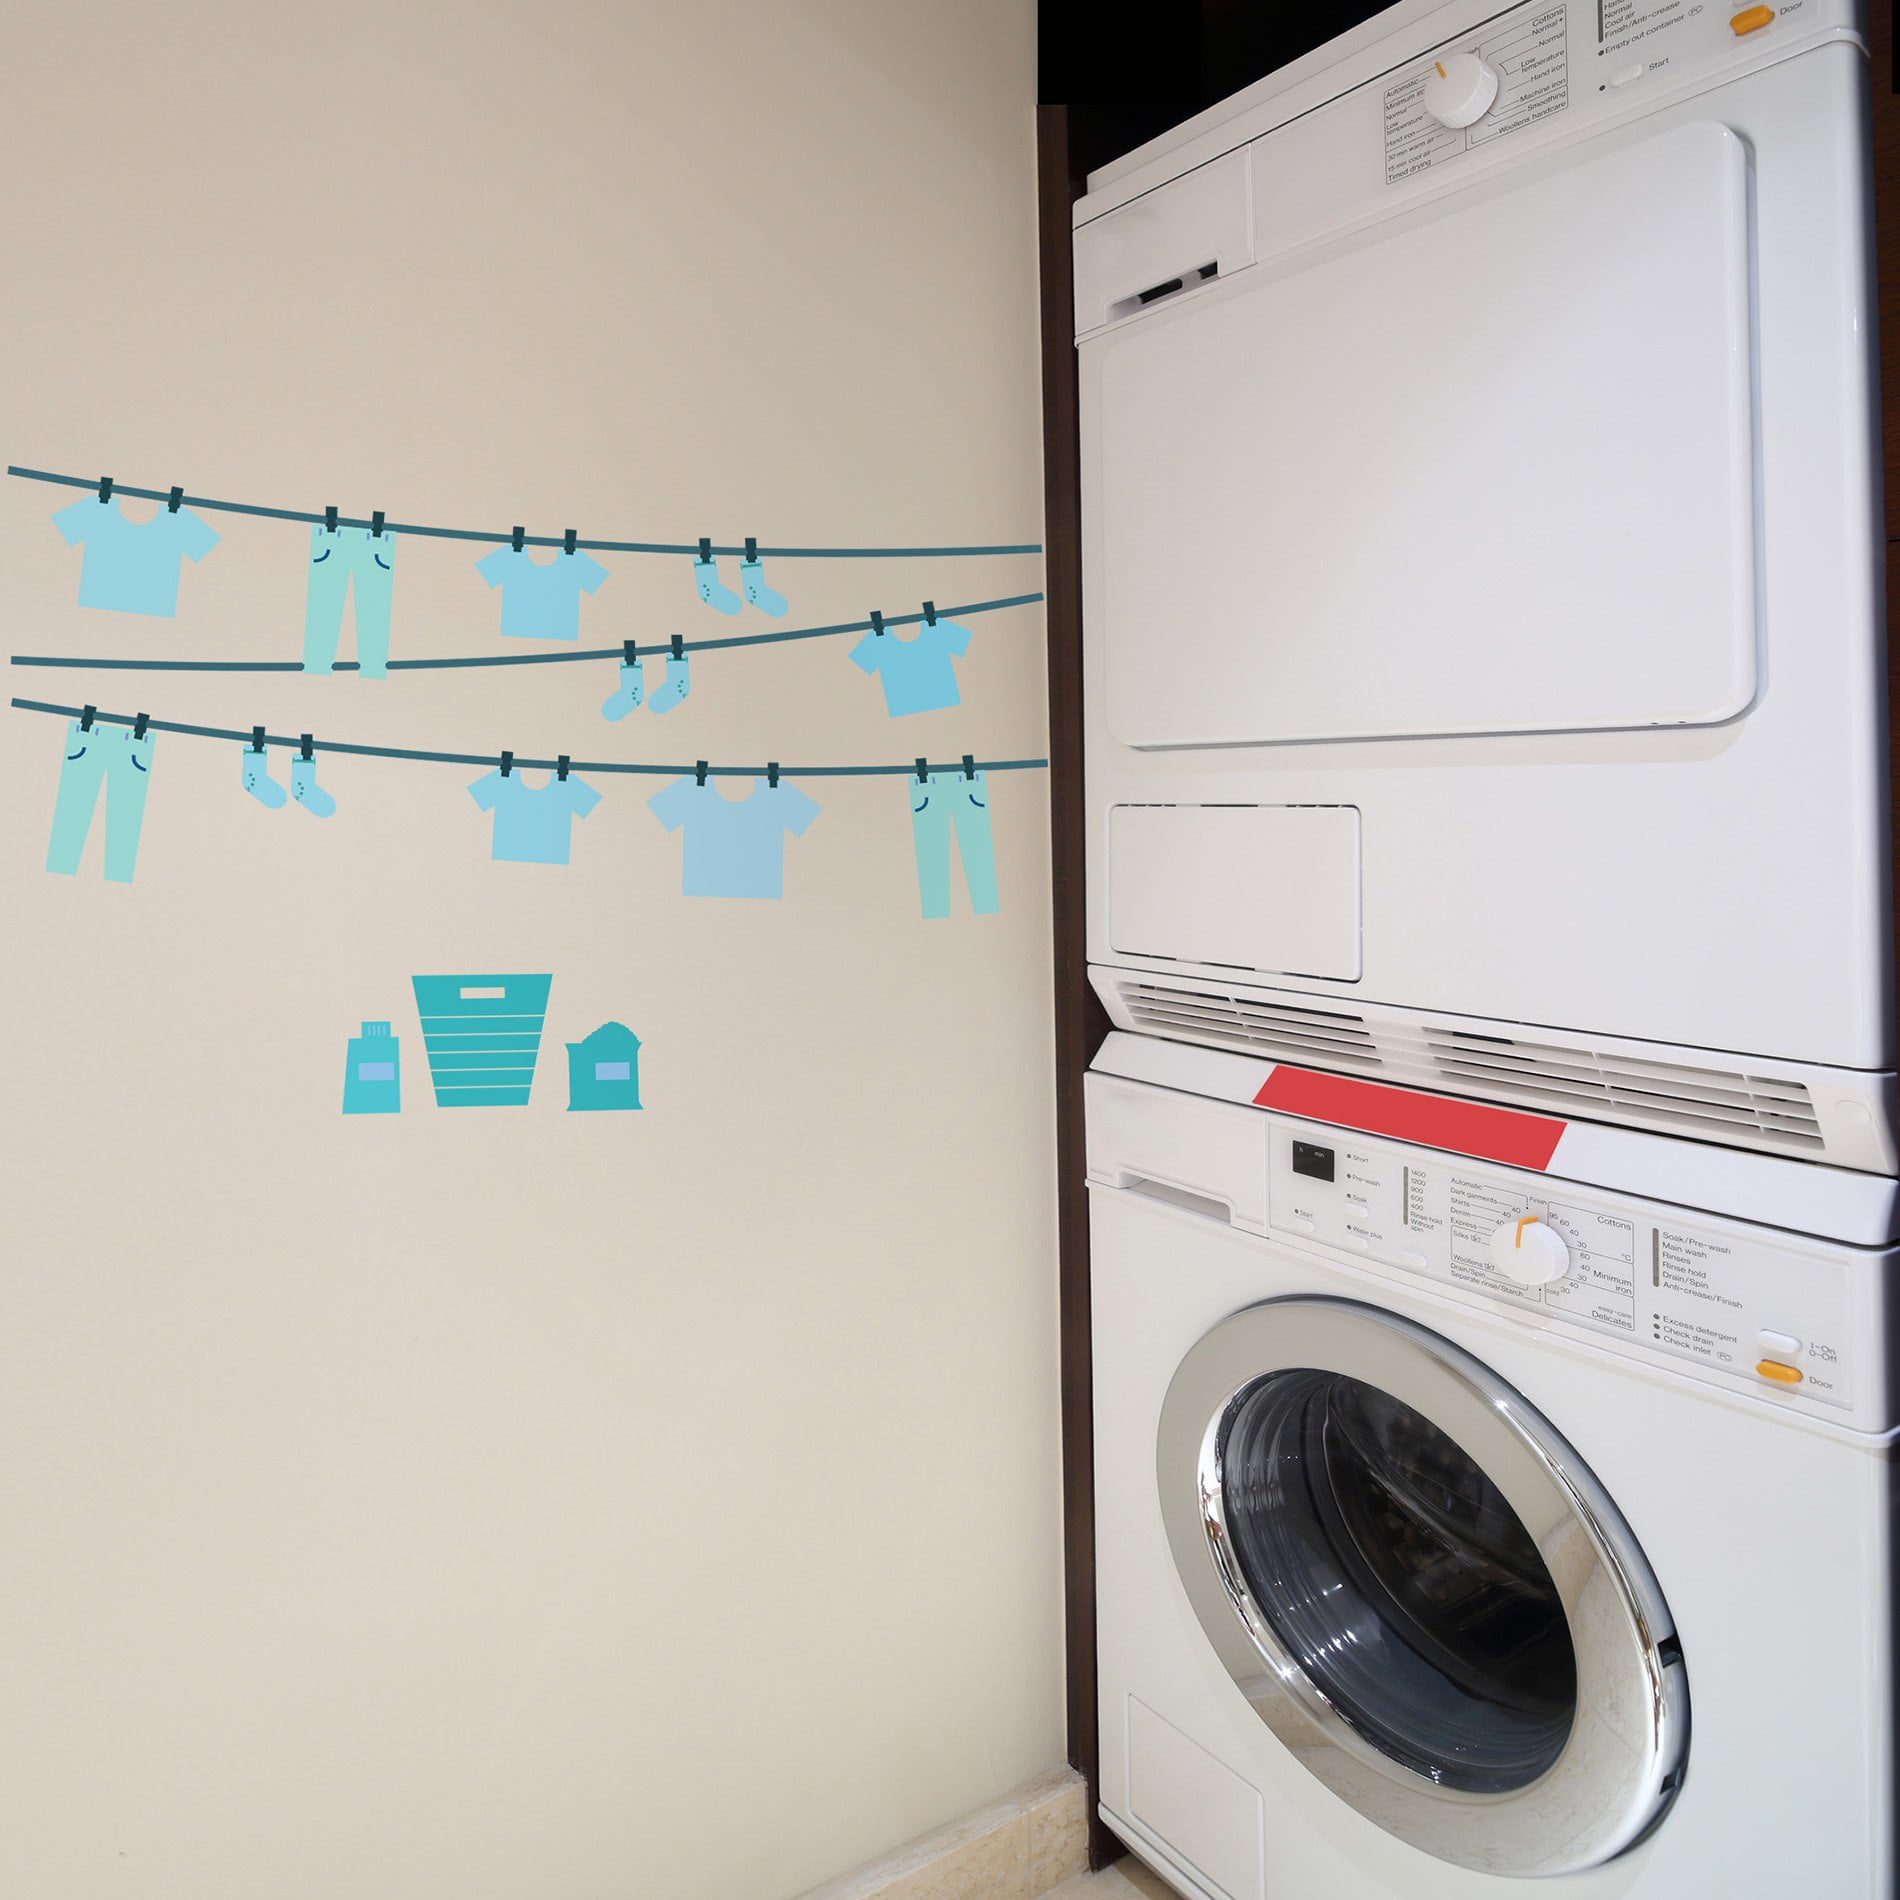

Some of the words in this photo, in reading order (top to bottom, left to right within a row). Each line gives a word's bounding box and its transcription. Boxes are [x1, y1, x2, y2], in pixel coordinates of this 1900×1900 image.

[1604, 2, 1632, 19] Normal
[1780, 2, 1803, 15] Door
[1532, 8, 1564, 27] Cottons
[1604, 17, 1623, 29] Cool
[1625, 11, 1635, 20] air
[1605, 1, 1681, 39] Finish/Anti-crease
[1531, 20, 1558, 36] Normal
[1605, 38, 1631, 54] Empty
[1631, 31, 1645, 42] out
[1646, 14, 1685, 35] container
[1538, 31, 1564, 47] Normal
[1520, 57, 1536, 67] Low
[1521, 50, 1565, 73] temperature
[1648, 57, 1669, 71] Start
[1530, 69, 1550, 82] Hand
[1551, 62, 1565, 73] iron
[1386, 79, 1419, 98] Automatic
[1520, 85, 1550, 102] Machine
[1551, 78, 1566, 89] iron
[1527, 91, 1566, 112] Smoothing
[1499, 117, 1530, 134] Woollens
[1532, 101, 1566, 119] handcare
[1388, 167, 1408, 181] Timed
[1409, 160, 1432, 174] drying
[1352, 1154, 1369, 1163] Short
[1411, 1169, 1426, 1178] 1400
[1411, 1178, 1426, 1186] 1200
[1451, 1178, 1483, 1190] Automatic
[1450, 1187, 1465, 1196] Dark
[1466, 1192, 1498, 1205] garments
[1451, 1197, 1470, 1207] Shirts
[1530, 1196, 1547, 1205] Finish
[1411, 1203, 1423, 1211] 400
[1451, 1207, 1471, 1217] Denim
[1411, 1211, 1427, 1221] Rinse
[1429, 1216, 1443, 1225] hold
[1411, 1219, 1434, 1230] Without
[1451, 1217, 1477, 1229] Express
[1597, 1216, 1632, 1231] Cottons
[1453, 1230, 1469, 1240] Silks
[1569, 1229, 1579, 1237] 40
[1577, 1241, 1587, 1249] 30
[1662, 1231, 1731, 1255] Soak/Pre-wash
[1663, 1241, 1682, 1252] Main
[1685, 1248, 1707, 1259] wash
[1453, 1254, 1483, 1268] Woollens
[1663, 1251, 1691, 1265] Rinses
[1451, 1263, 1486, 1278] Drain/Spin
[1663, 1261, 1686, 1274] Rinse
[1688, 1268, 1707, 1279] hold
[1451, 1269, 1480, 1284] Separate
[1481, 1280, 1524, 1297] rinse/Starch
[1569, 1281, 1579, 1289] 40
[1593, 1270, 1632, 1287] Minimum
[1662, 1271, 1709, 1290] Drain/Spin
[1560, 1286, 1570, 1294] 30
[1615, 1285, 1632, 1295] iron
[1663, 1281, 1743, 1309] Anti-crease/Finish
[1592, 1310, 1632, 1329] Delicates
[1663, 1315, 1694, 1331] Excess
[1696, 1323, 1738, 1344] detergent
[1664, 1325, 1690, 1339] Check
[1692, 1335, 1714, 1347] drain
[1664, 1335, 1690, 1350] Check
[1693, 1345, 1711, 1356] inlet
[1809, 1376, 1833, 1389] Door
